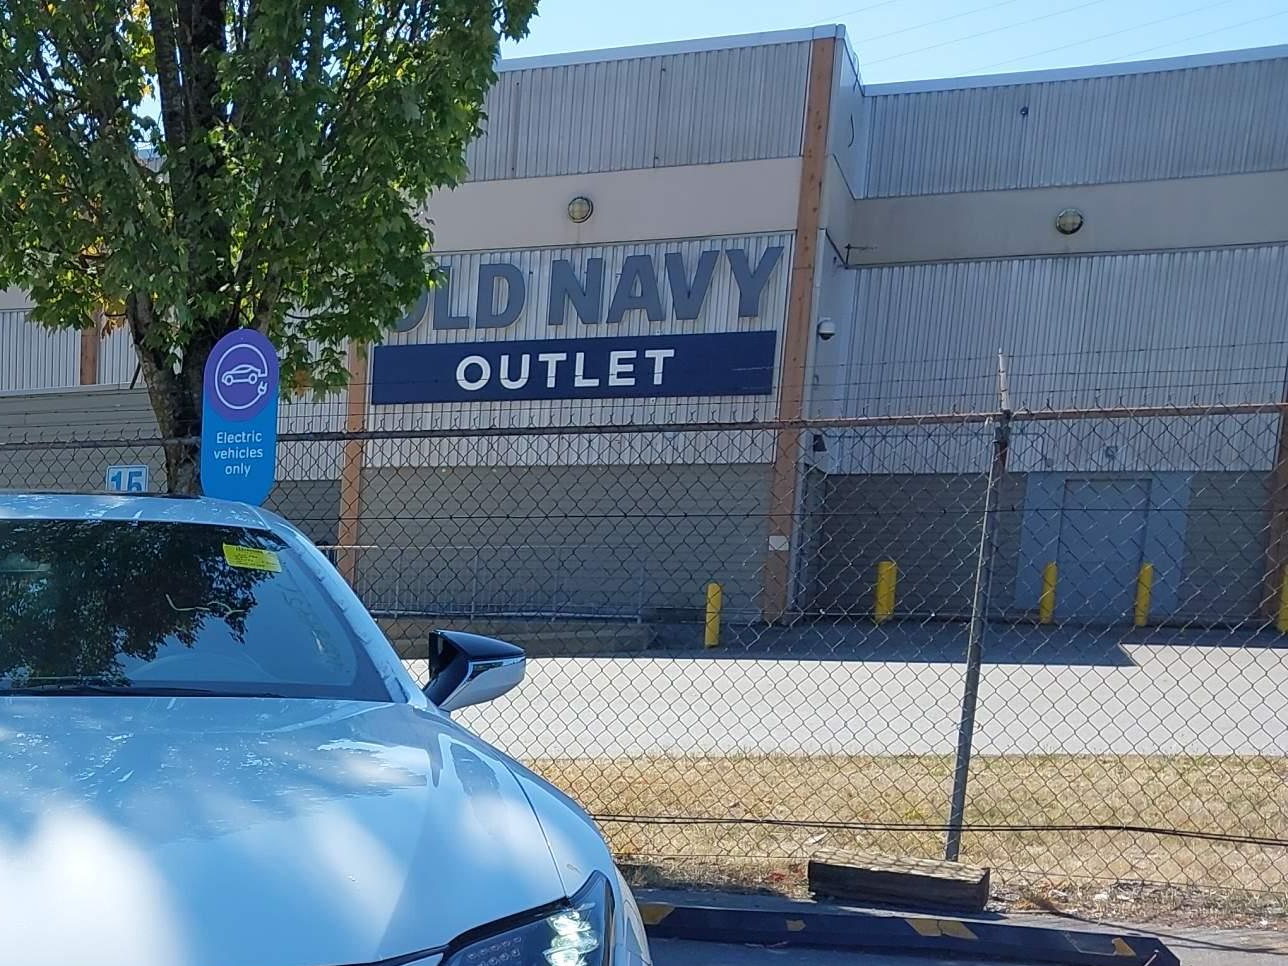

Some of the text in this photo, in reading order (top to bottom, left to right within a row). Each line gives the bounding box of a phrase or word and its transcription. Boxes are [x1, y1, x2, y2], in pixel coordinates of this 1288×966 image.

[547, 246, 785, 326] NAVY
[455, 348, 676, 392] OUTLET
[216, 430, 263, 444] Electric
[213, 446, 264, 460] vehicles
[225, 462, 252, 478] only
[110, 470, 144, 492] 15
